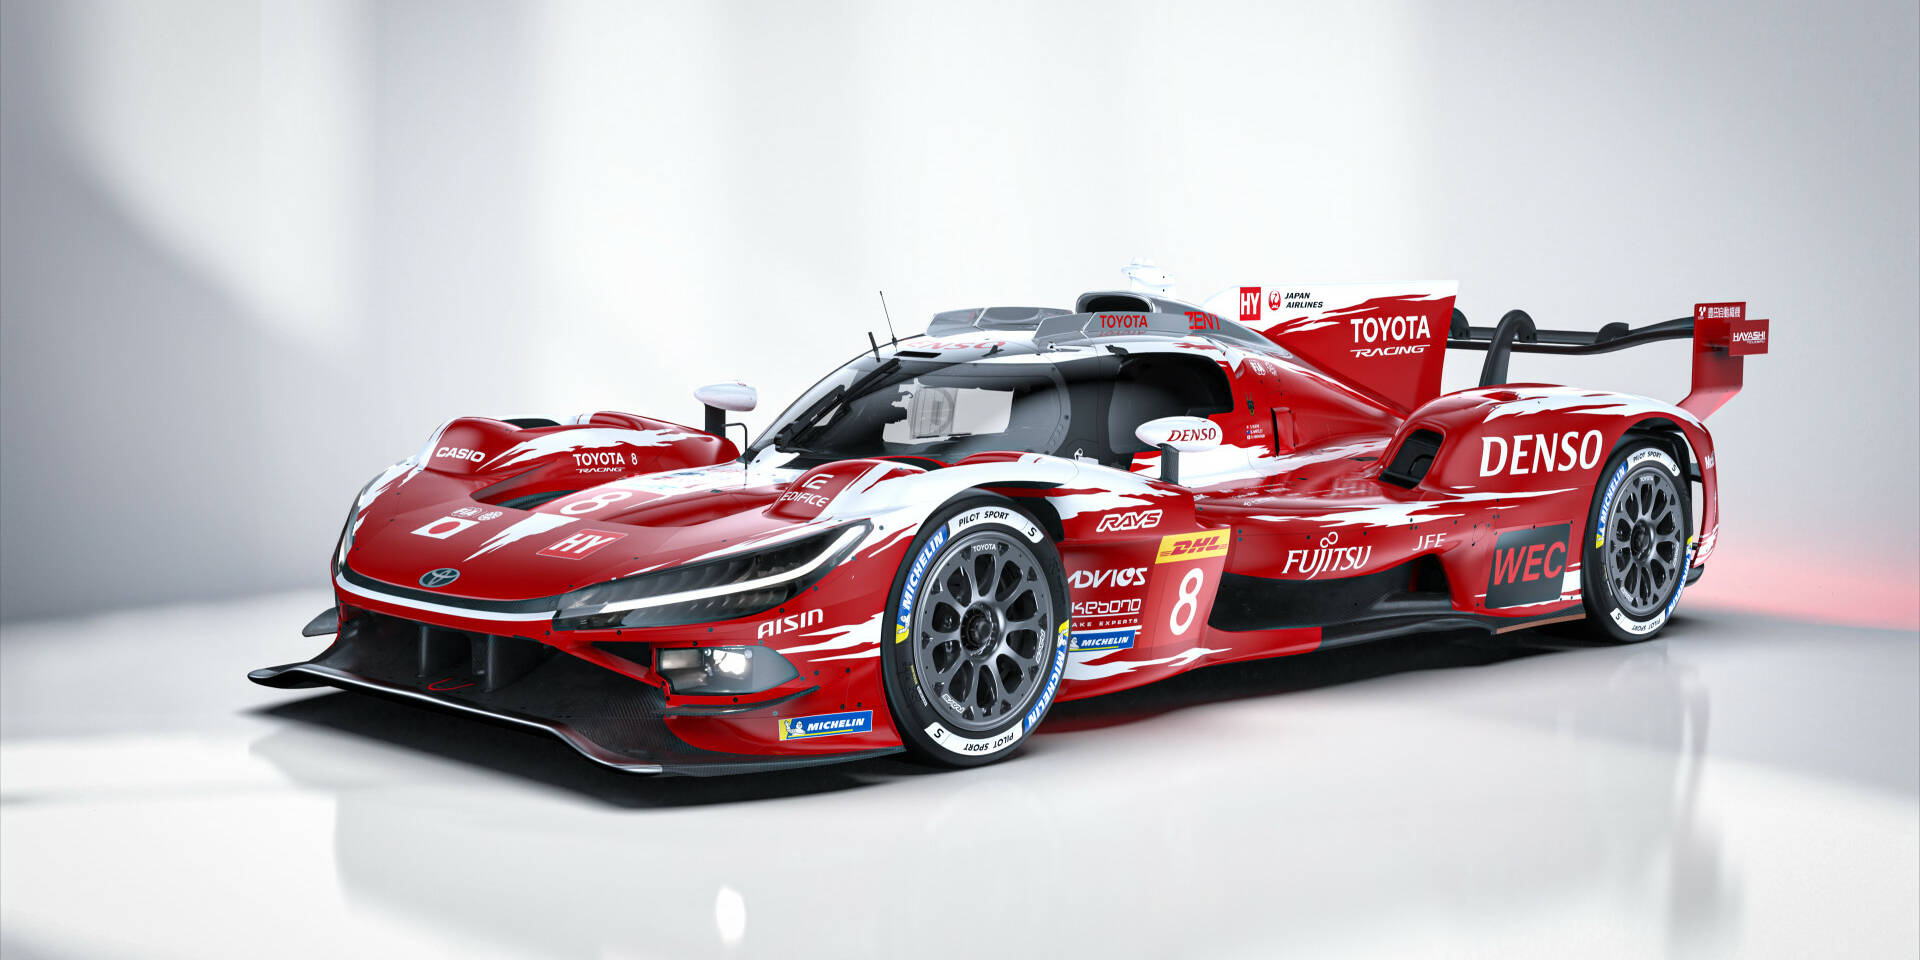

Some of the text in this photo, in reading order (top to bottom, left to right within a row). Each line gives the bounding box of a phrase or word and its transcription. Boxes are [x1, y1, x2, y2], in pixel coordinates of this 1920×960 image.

[1241, 293, 1260, 315] HY
[1284, 292, 1310, 300] JAPAN
[1286, 301, 1323, 309] AIRLINES
[1099, 314, 1148, 328] TOYOTA
[1351, 315, 1431, 343] TOYOTA
[1732, 331, 1766, 342] HAYASHI
[1351, 344, 1431, 358] RACING
[1167, 428, 1216, 442] DENSO
[436, 447, 486, 463] CASIO
[573, 452, 638, 467] TOYOTA 8
[1479, 430, 1603, 478] DENSO
[1633, 451, 1662, 462] PILOT SPORT
[560, 491, 633, 515] 8
[780, 490, 829, 508] EDIFICE
[1600, 466, 1625, 524] MICHELIN
[958, 510, 1010, 527] PILOT SPORT
[1096, 509, 1163, 532] RAYS
[1027, 527, 1037, 537] S
[549, 532, 617, 554] HY
[972, 543, 997, 552] TOYOTA
[1169, 535, 1221, 556] DHL
[1412, 533, 1448, 551] JFE
[1281, 543, 1372, 580] FUJITSU
[1493, 541, 1566, 586] WEC
[902, 531, 945, 611] MICHELIN
[1072, 598, 1141, 614] kebono
[1169, 567, 1204, 636] 8
[757, 608, 823, 639] AISIN
[1099, 618, 1138, 627] EXPERTS
[1081, 635, 1129, 647] MICHELIN
[1027, 651, 1067, 727] MICHELIN
[807, 717, 865, 732] MICHELIN
[933, 728, 944, 738] S
[963, 732, 1014, 752] PILOT SPORT
